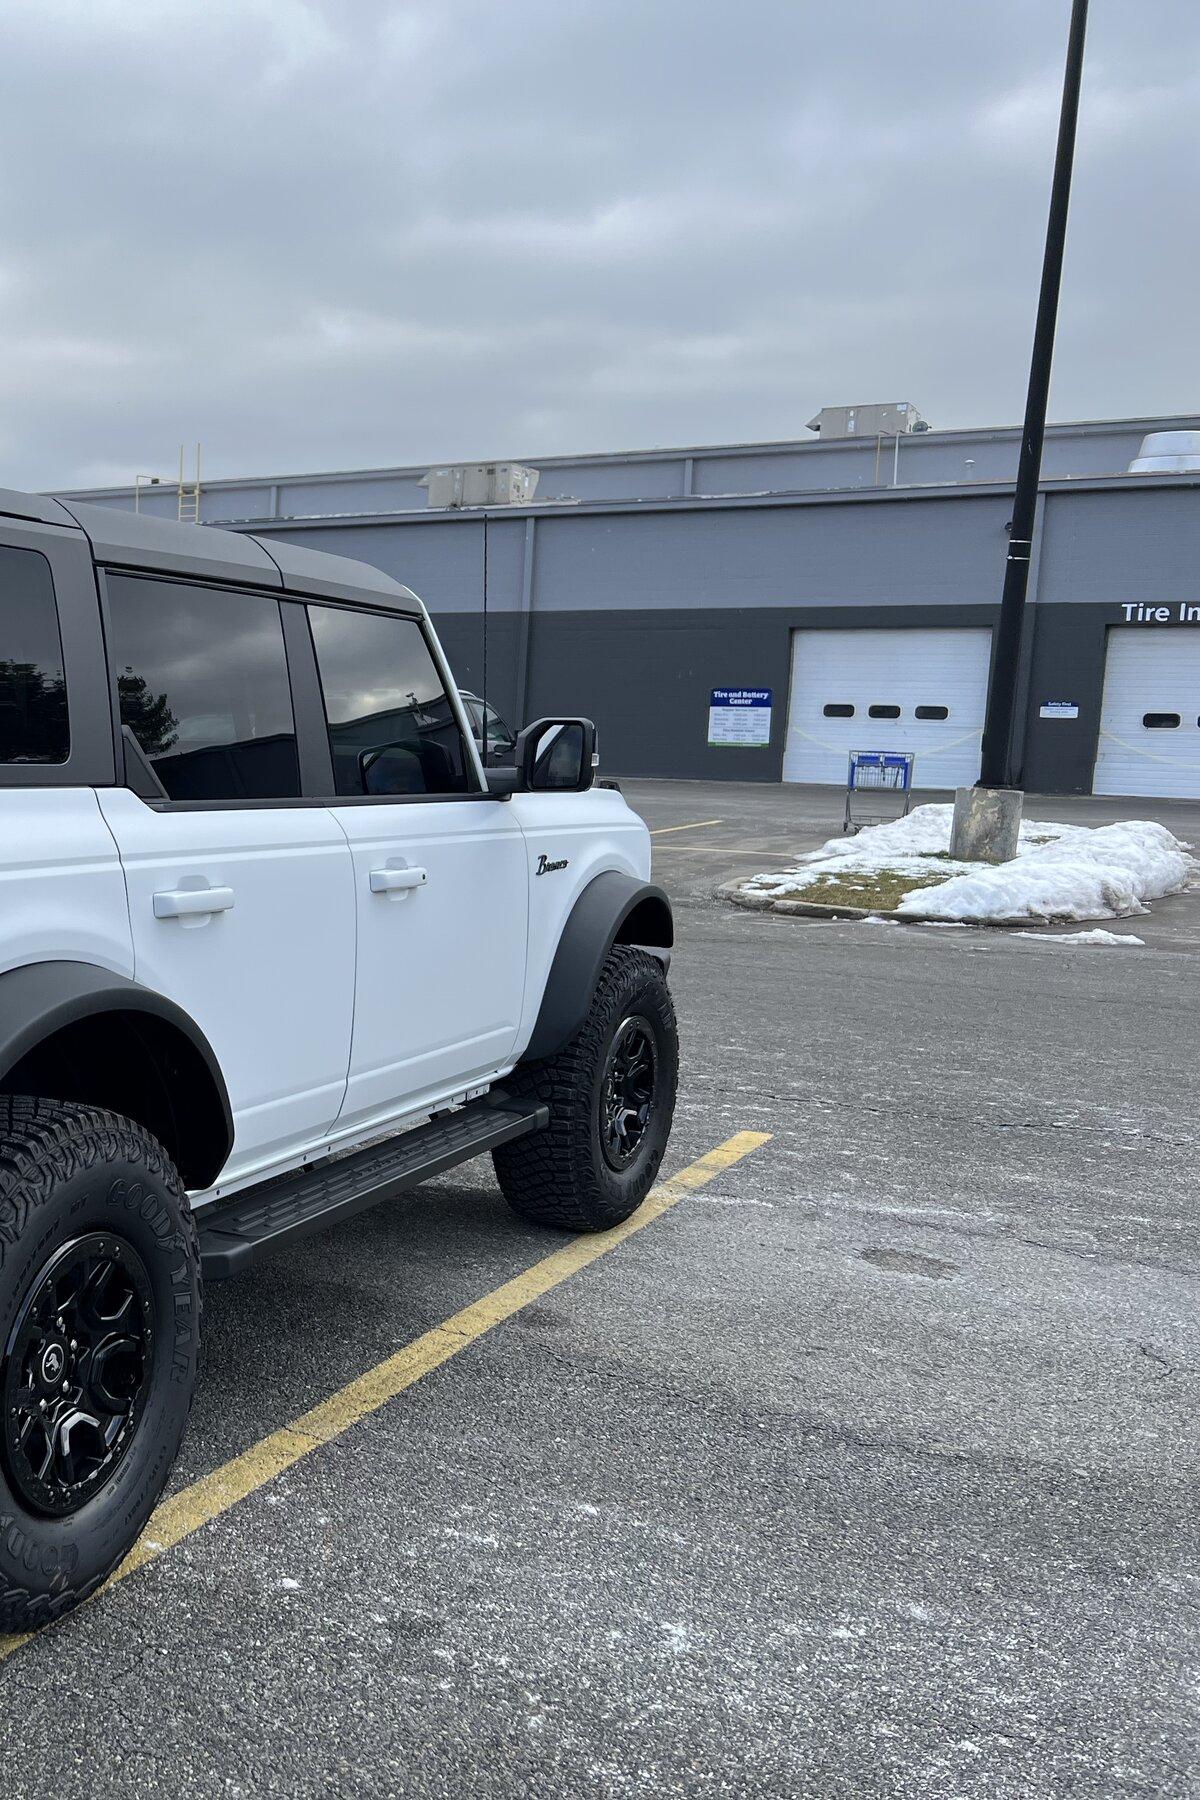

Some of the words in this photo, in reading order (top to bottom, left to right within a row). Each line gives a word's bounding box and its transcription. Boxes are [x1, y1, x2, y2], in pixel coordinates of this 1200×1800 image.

[1121, 603, 1170, 621] Tire
[536, 854, 569, 876] Bronco
[106, 1177, 194, 1384] GOODYEAR
